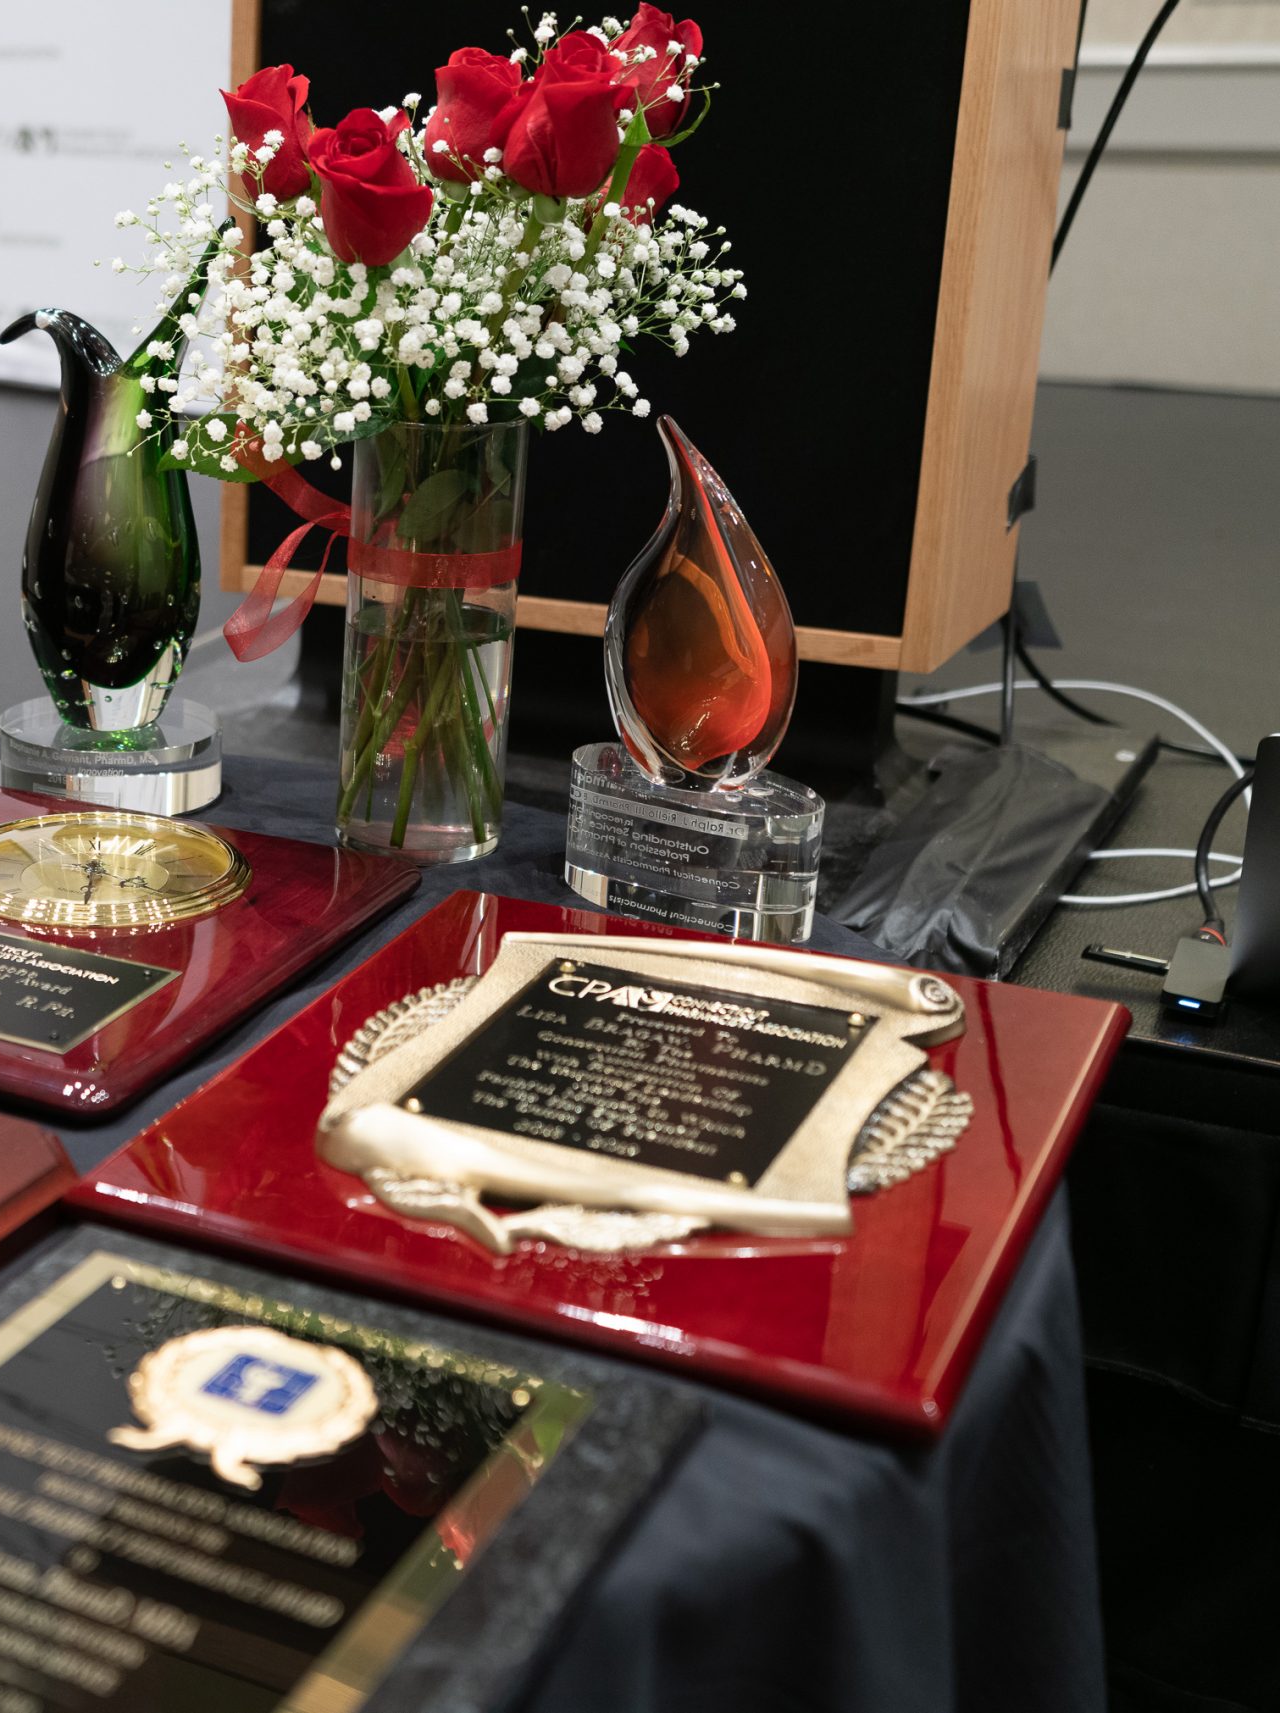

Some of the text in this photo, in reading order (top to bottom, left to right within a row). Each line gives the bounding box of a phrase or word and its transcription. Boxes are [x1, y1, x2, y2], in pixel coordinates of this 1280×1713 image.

[24, 958, 120, 985] ASSOCIATION
[15, 976, 73, 996] Award
[548, 975, 638, 1007] CPA
